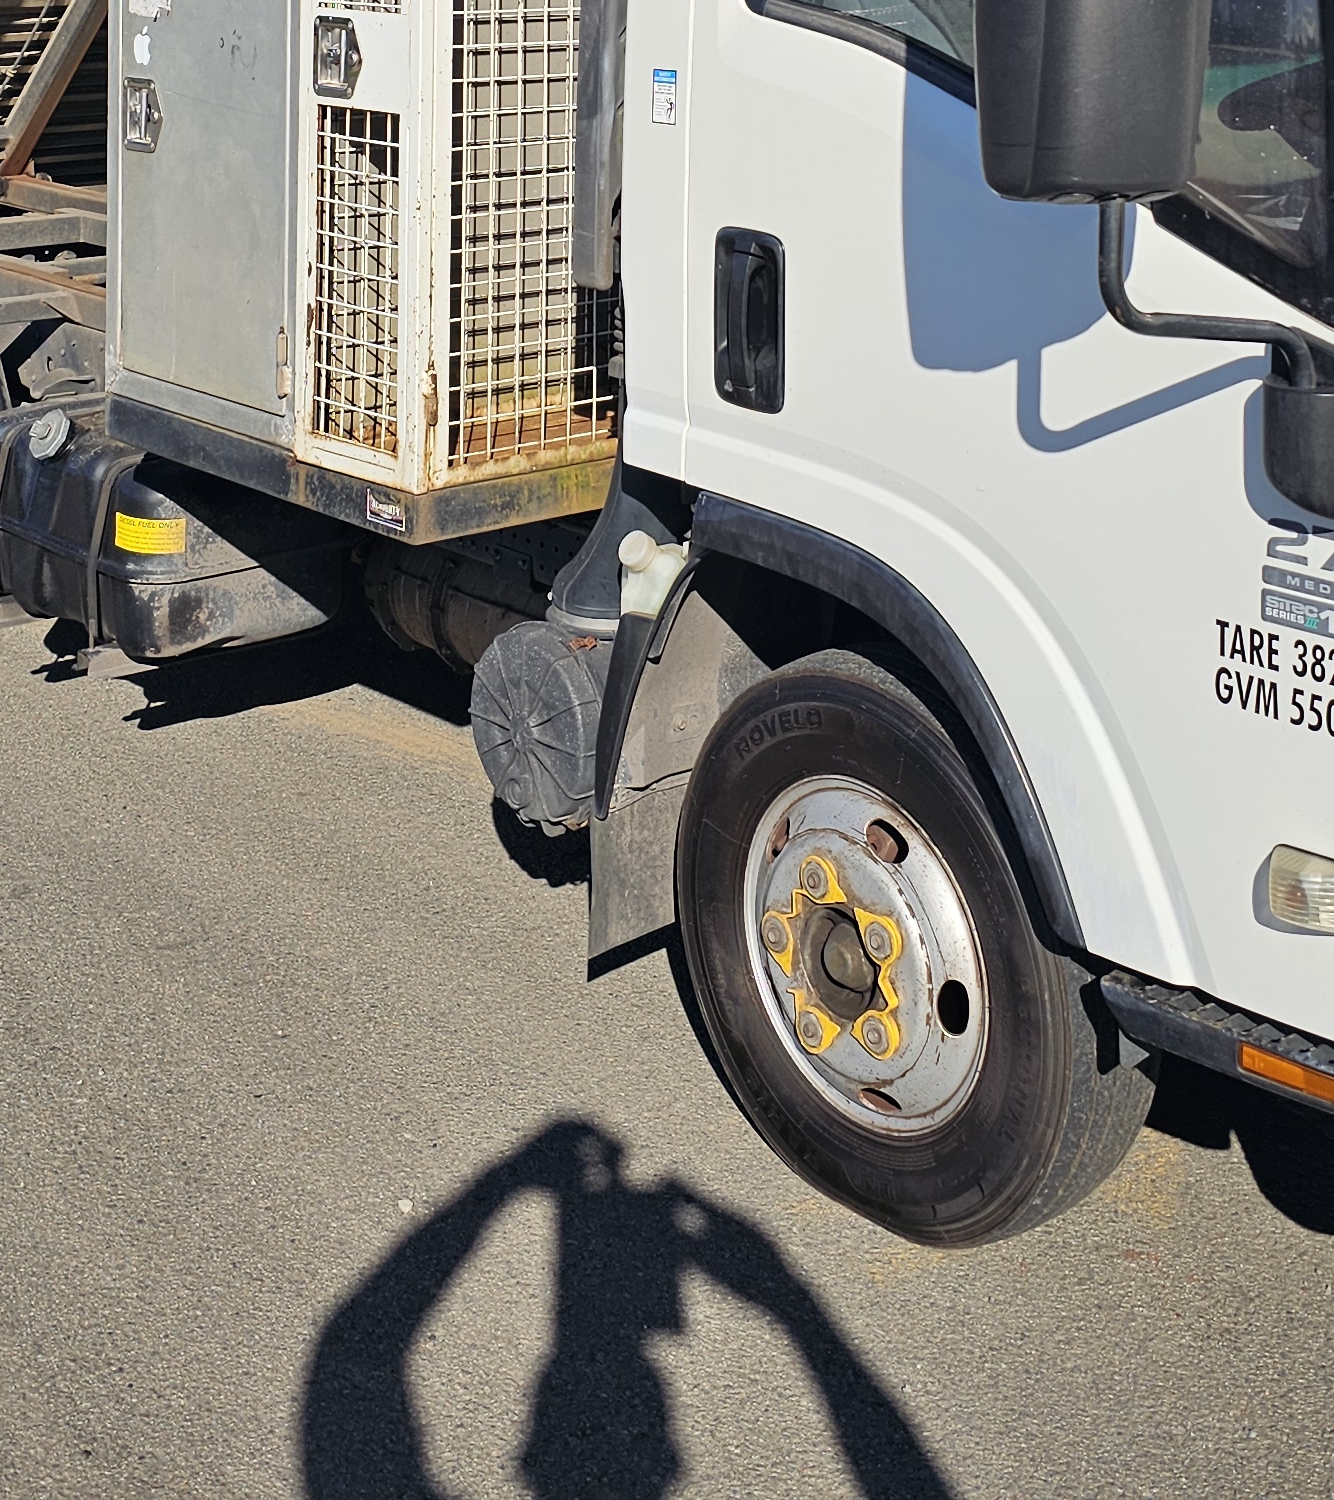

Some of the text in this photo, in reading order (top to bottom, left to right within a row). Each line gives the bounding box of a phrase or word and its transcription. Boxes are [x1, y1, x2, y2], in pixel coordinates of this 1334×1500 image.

[158, 520, 180, 529] ONLY
[1265, 606, 1305, 624] SERIES
[1215, 618, 1280, 672] TARE
[1215, 666, 1280, 720] GVM
[733, 707, 823, 760] ROVELO
